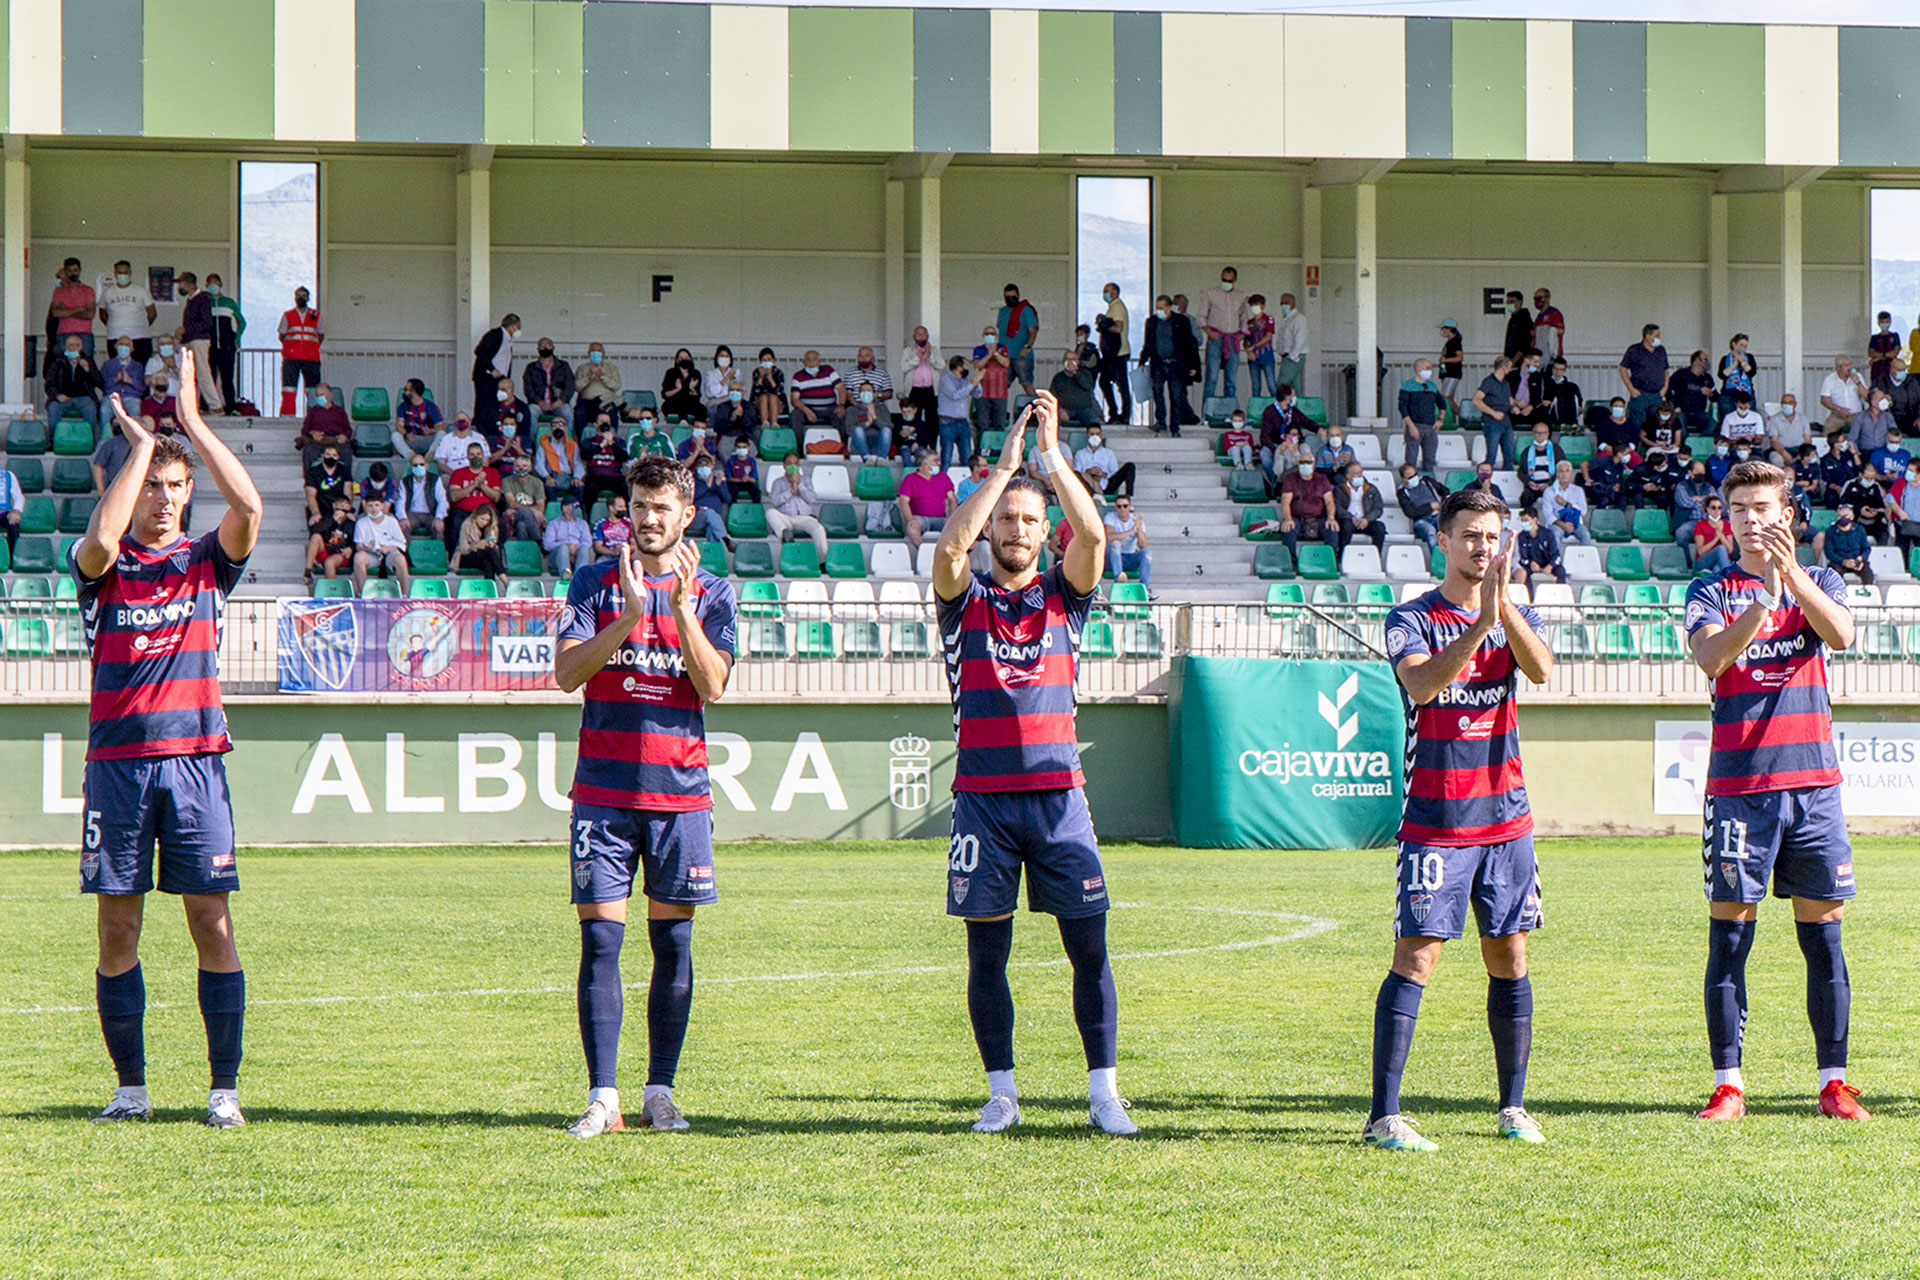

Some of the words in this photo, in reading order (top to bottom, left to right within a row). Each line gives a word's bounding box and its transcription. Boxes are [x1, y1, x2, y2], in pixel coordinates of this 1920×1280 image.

[652, 274, 674, 302] F
[1483, 287, 1505, 315] E
[1163, 464, 1173, 474] 6
[1169, 488, 1178, 499] 5
[1181, 526, 1190, 537] 4
[1195, 564, 1204, 576] 3
[498, 644, 551, 664] VAR
[1838, 732, 1915, 763] letas
[291, 732, 850, 814] ALBURA
[1239, 742, 1393, 785] cajaviva
[1311, 779, 1393, 801] cajarural
[1842, 774, 1914, 788] TALARIA
[86, 810, 101, 849] 5
[575, 820, 593, 858] 3
[1721, 821, 1752, 859] 11
[950, 834, 981, 873] 20
[1406, 852, 1444, 892] 10
